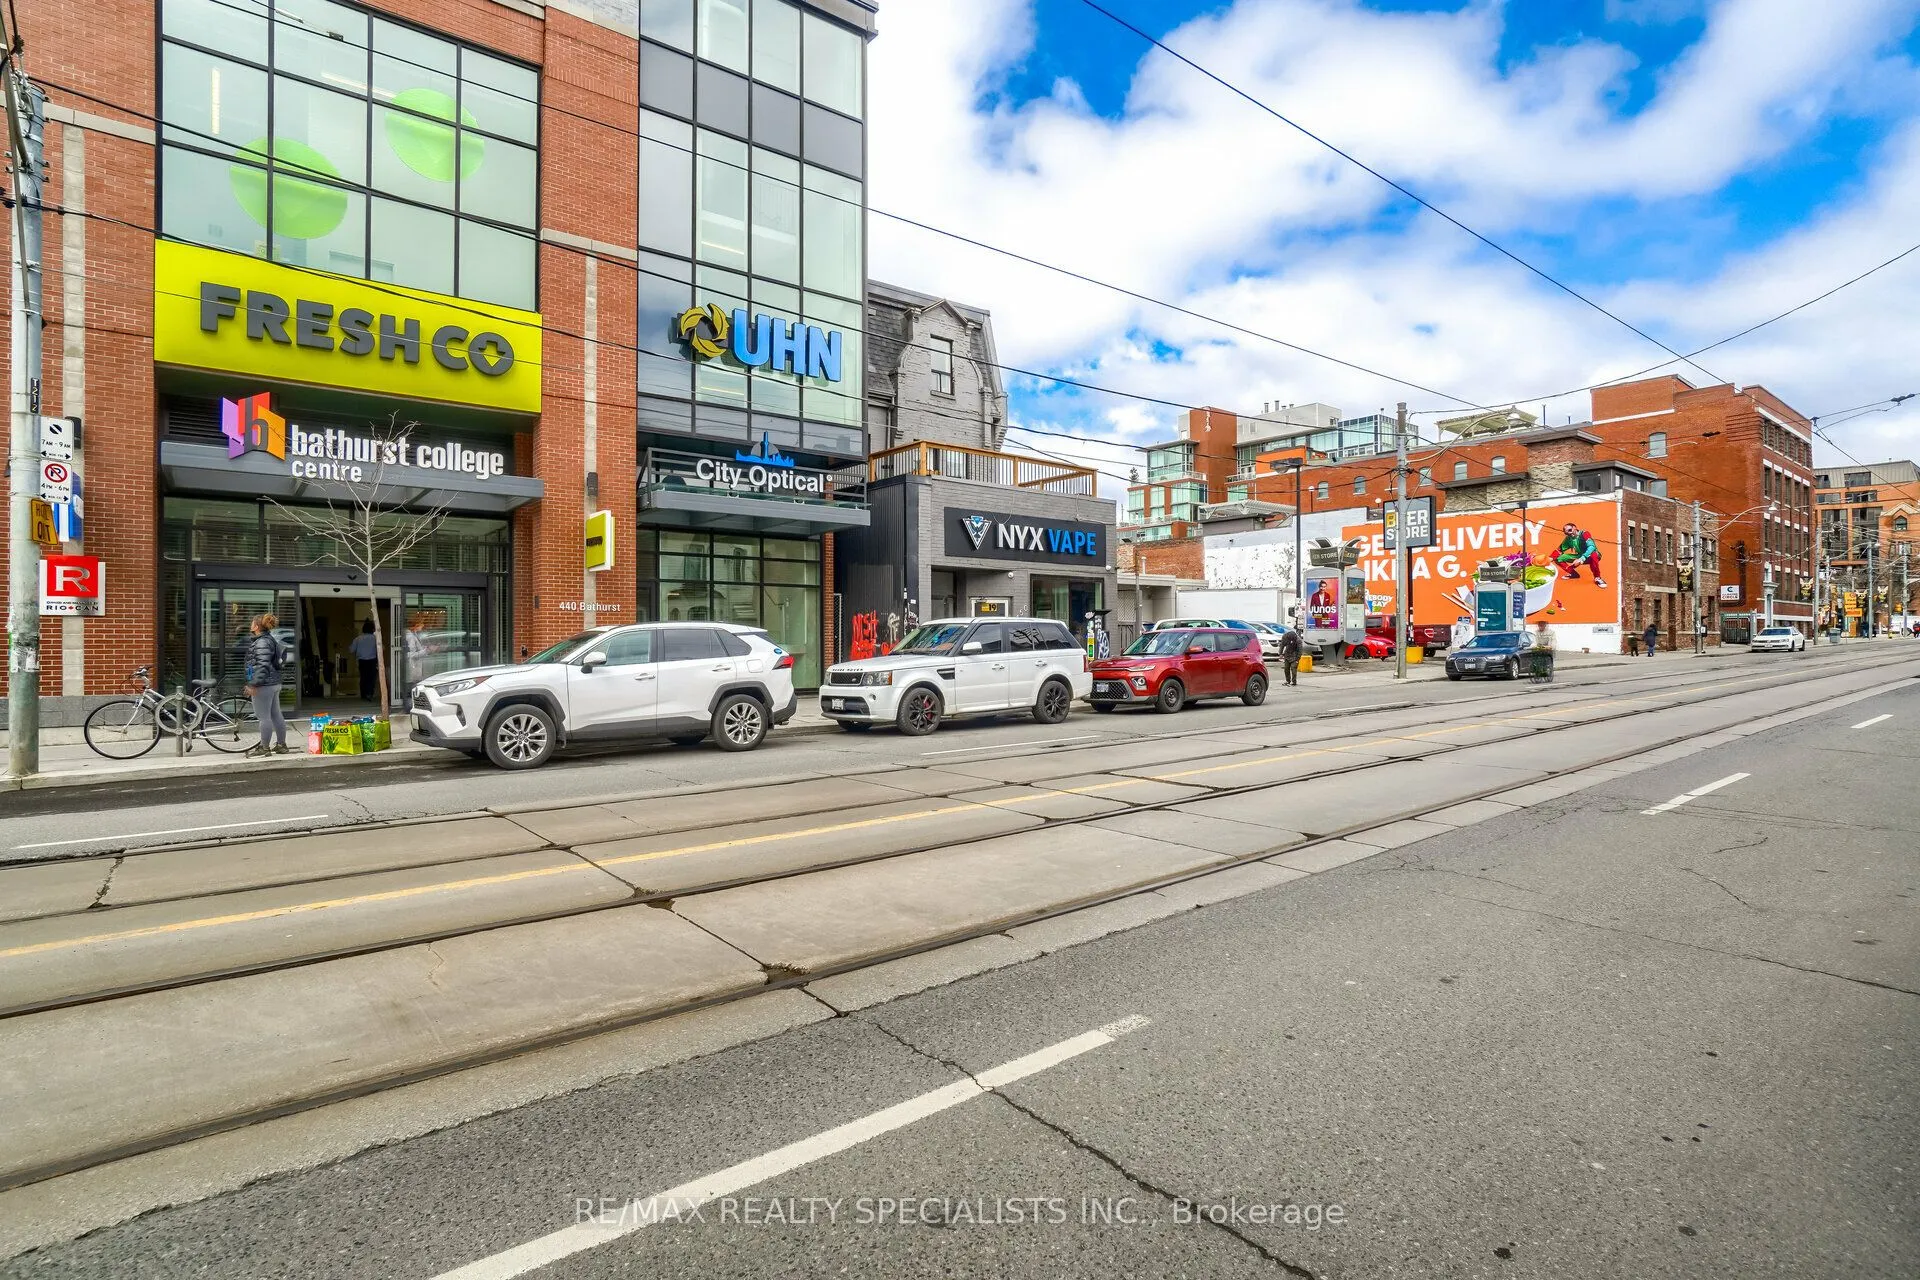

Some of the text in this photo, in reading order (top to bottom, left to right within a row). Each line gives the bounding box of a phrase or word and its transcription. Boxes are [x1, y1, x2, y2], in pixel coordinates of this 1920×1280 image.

[201, 281, 514, 376] FRESH CO
[732, 307, 842, 382] UHN
[291, 424, 504, 479] bathurst college
[291, 459, 362, 483] centre
[695, 458, 742, 488] City
[1385, 509, 1428, 528] BER
[998, 523, 1097, 557] NYX VAPE
[1355, 519, 1546, 558] GE LIVERY
[1386, 526, 1429, 541] SRE
[1320, 551, 1338, 559] STORE
[1364, 554, 1468, 582] IK A G.
[55, 565, 91, 592] R
[559, 602, 621, 612] 440 Bathurst
